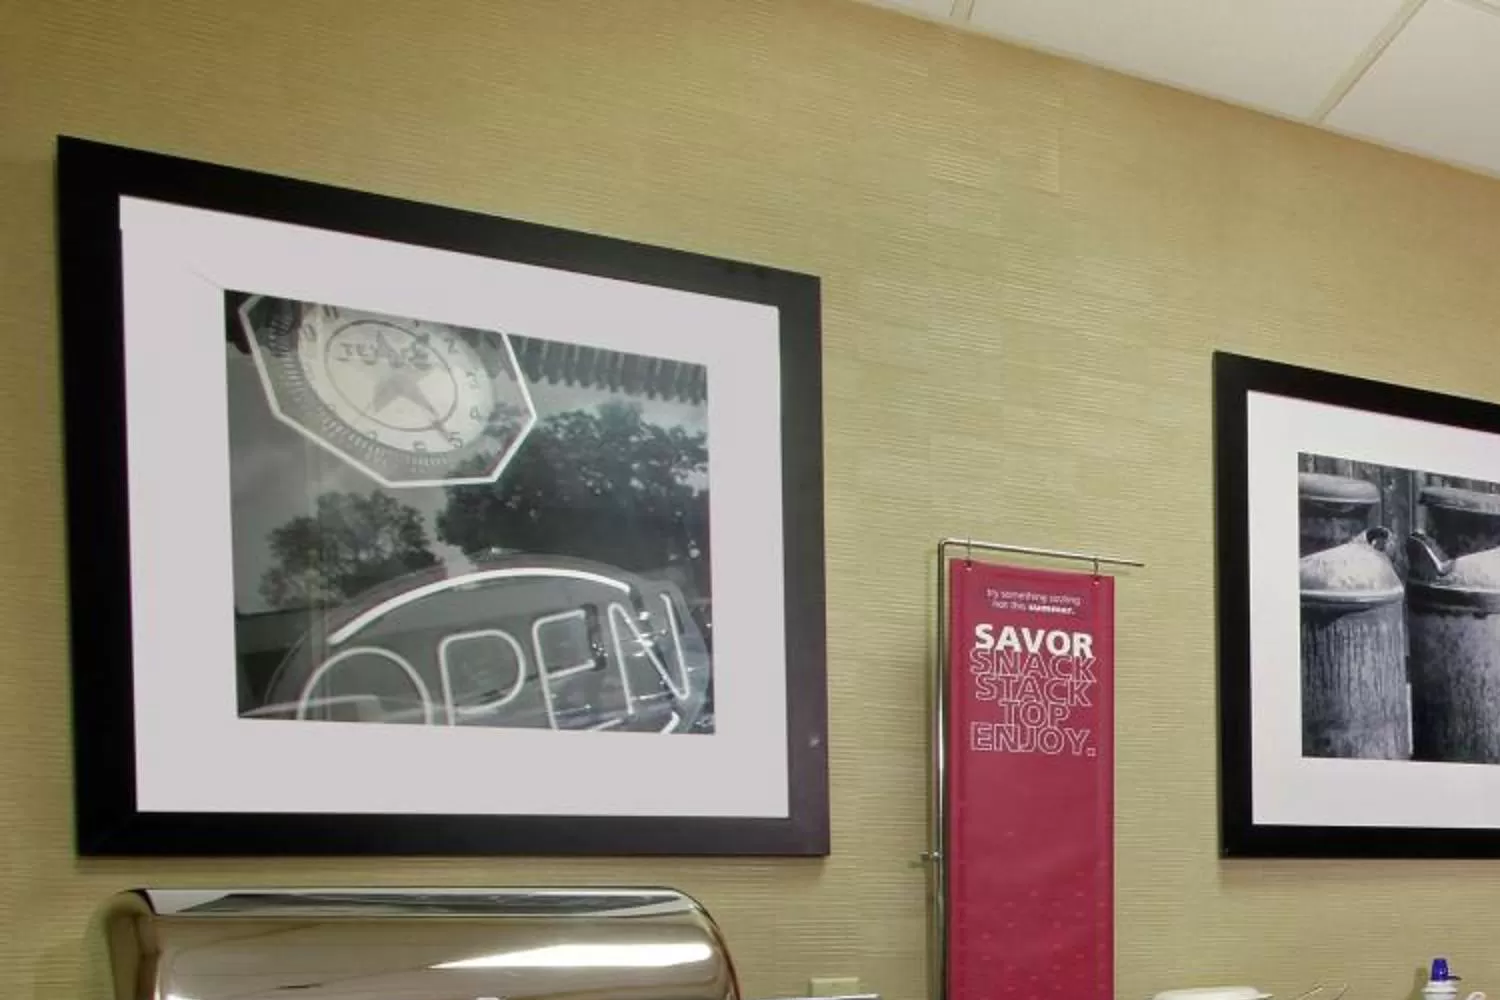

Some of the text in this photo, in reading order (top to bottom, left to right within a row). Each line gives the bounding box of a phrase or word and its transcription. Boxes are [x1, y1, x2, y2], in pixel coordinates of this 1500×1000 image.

[975, 623, 1093, 658] SAVOR
[970, 647, 1096, 682] SNACK
[976, 673, 1092, 707] STACK
[998, 700, 1070, 728] TOP
[970, 721, 1097, 757] ENJOY.
